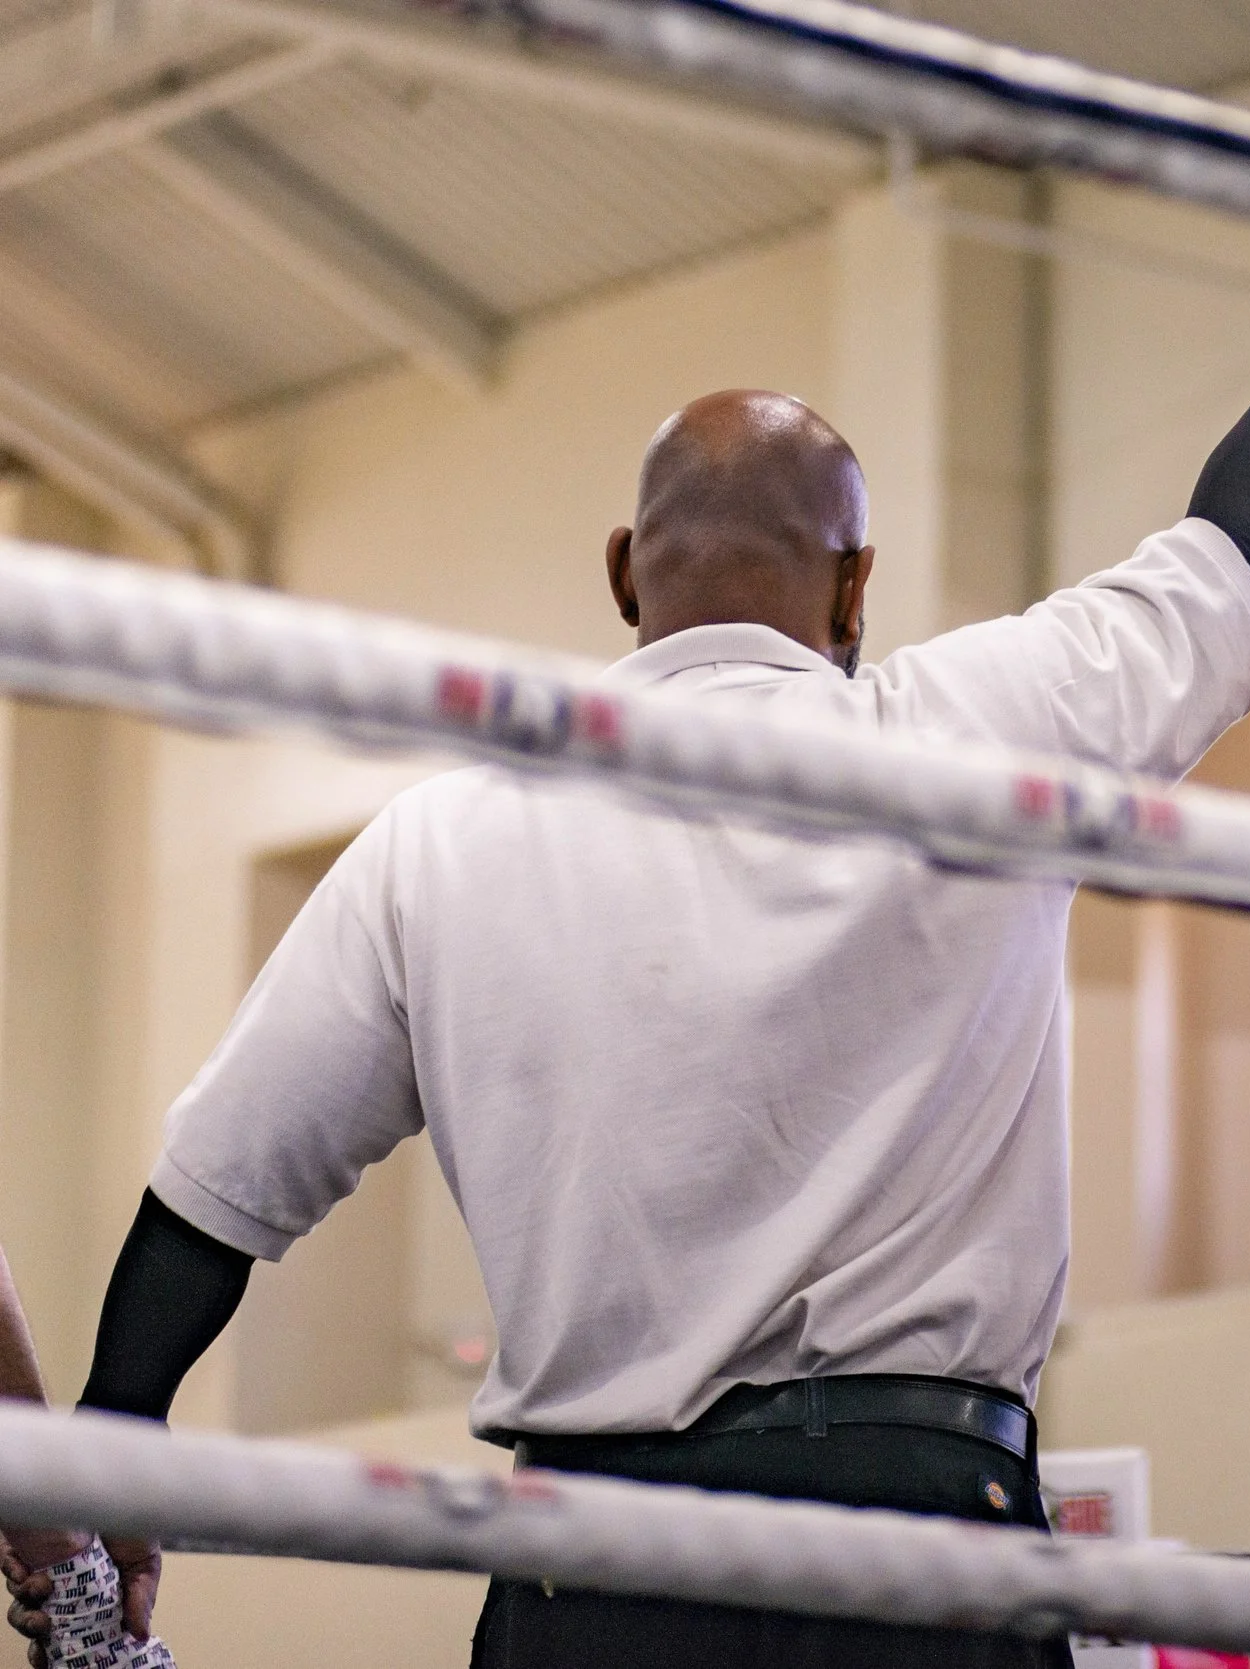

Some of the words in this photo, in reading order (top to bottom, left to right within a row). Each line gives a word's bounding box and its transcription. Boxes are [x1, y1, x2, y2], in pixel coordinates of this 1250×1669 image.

[52, 1560, 75, 1575] TITLE
[77, 1568, 96, 1586] TITLE
[65, 1585, 87, 1599] TITLE
